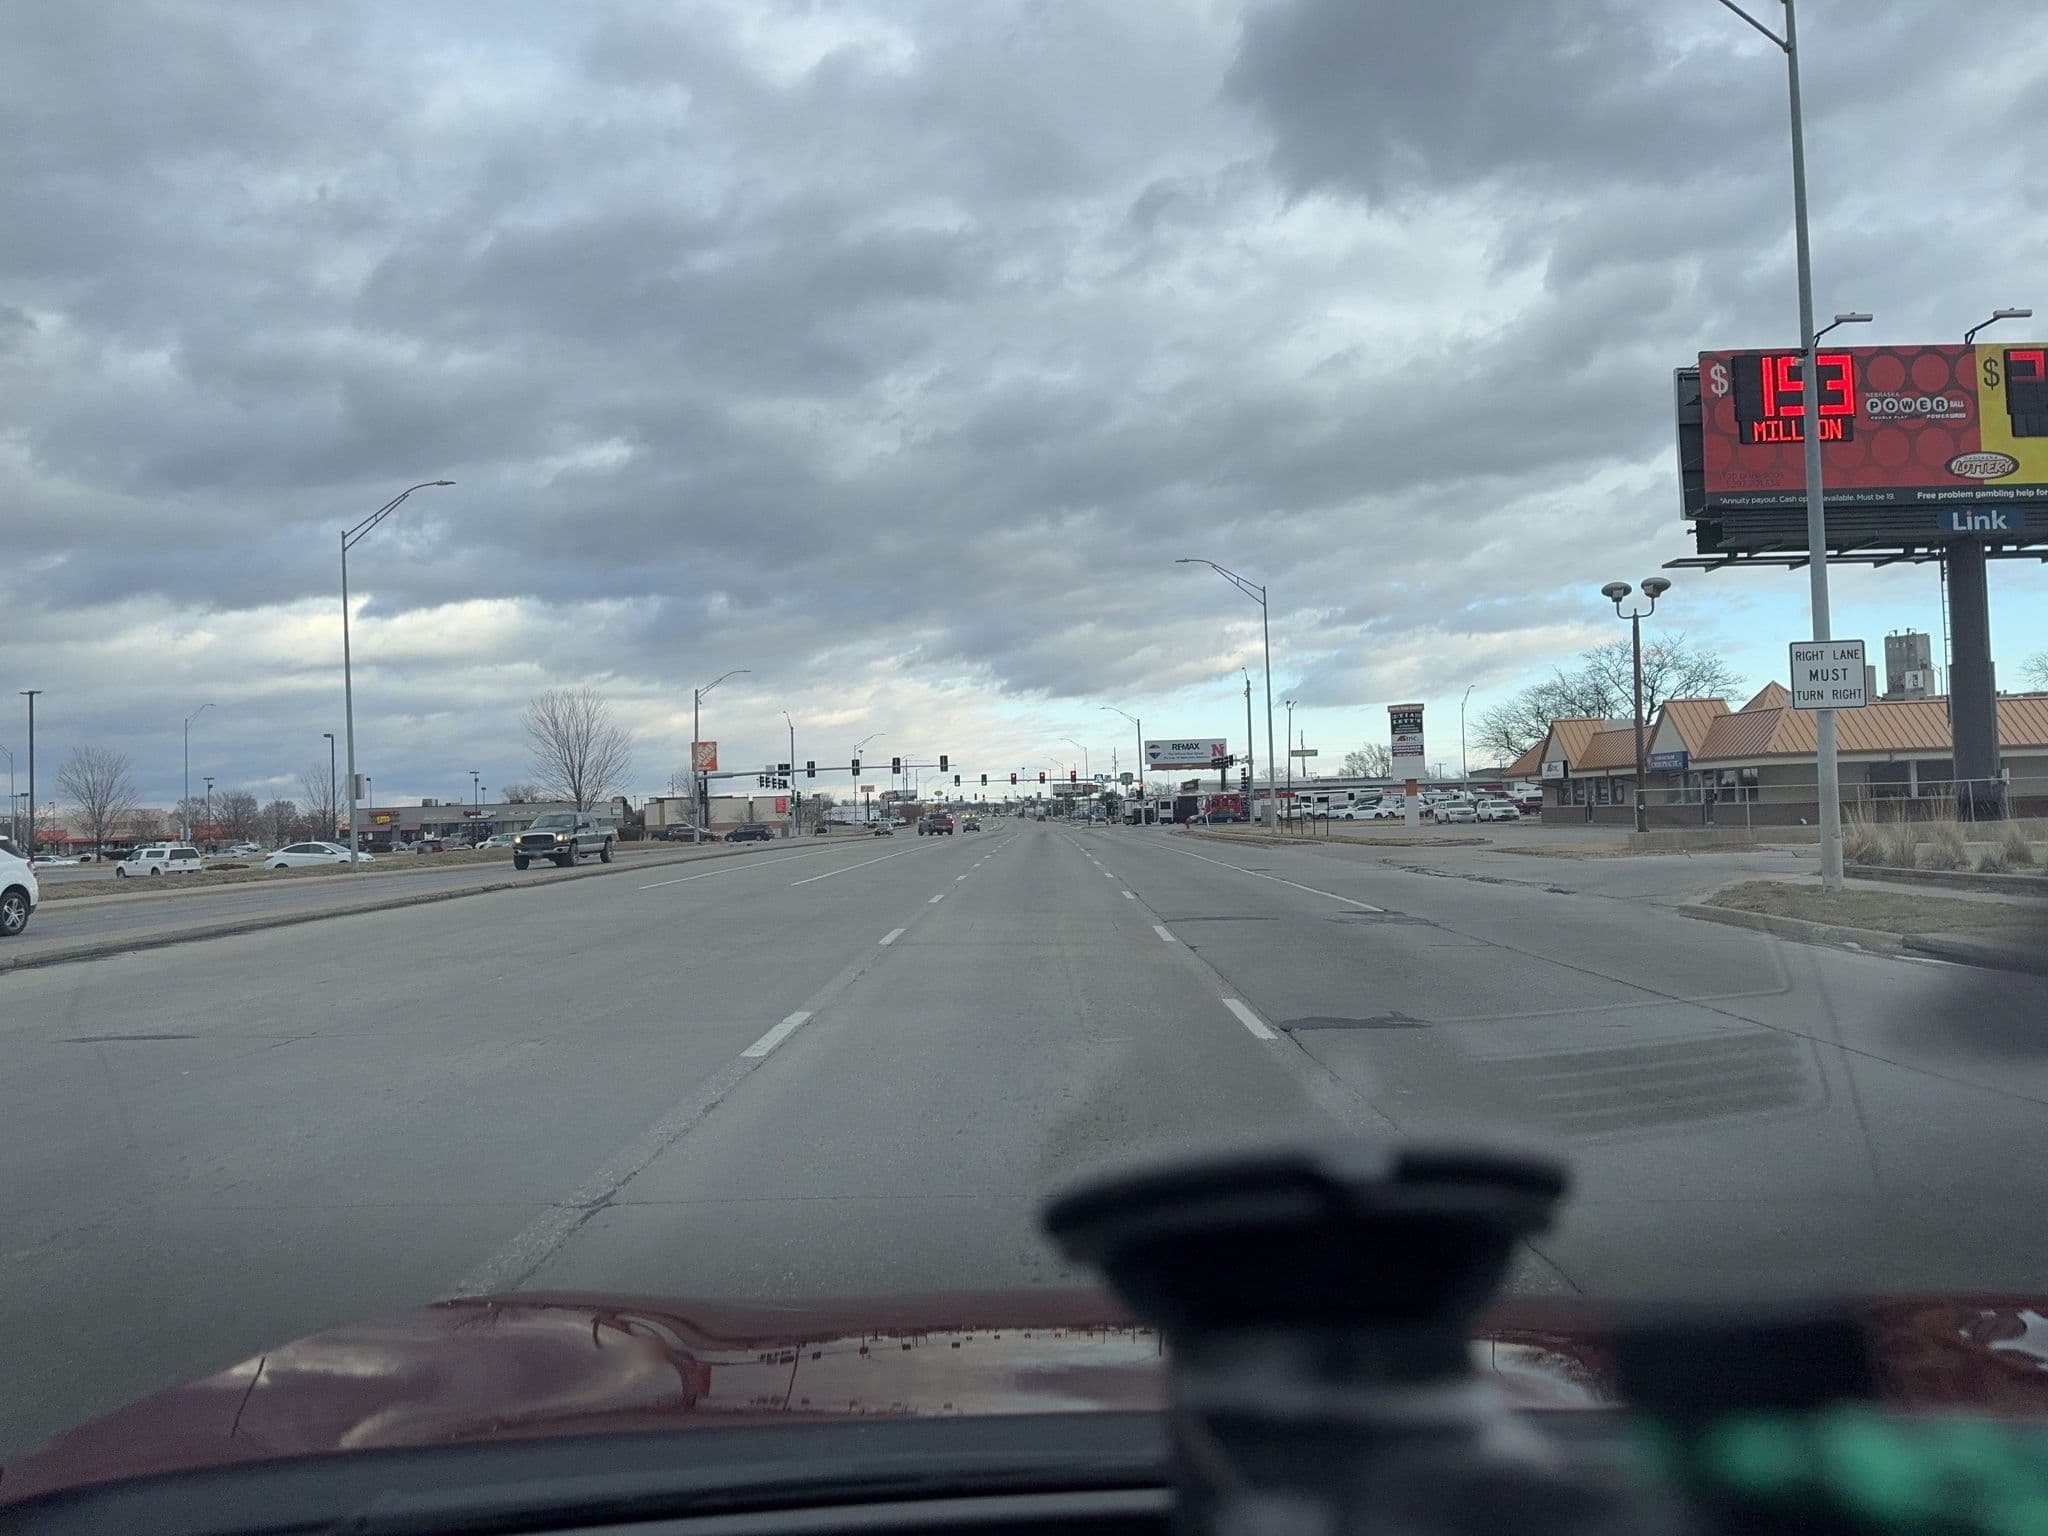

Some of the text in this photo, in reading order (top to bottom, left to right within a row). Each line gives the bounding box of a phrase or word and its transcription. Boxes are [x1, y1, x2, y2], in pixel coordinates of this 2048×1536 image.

[1710, 363, 1729, 397] $
[1983, 356, 2000, 391] $
[1754, 418, 1842, 442] MILLON
[1954, 459, 2013, 475] LOTTERY
[1780, 495, 1797, 503] Cash
[1917, 488, 2048, 500] Free problem gambling help for
[1952, 510, 2007, 531] Link
[1795, 649, 1861, 661] RIGHT LANE
[1809, 668, 1848, 682] MUST
[1796, 688, 1862, 701] TURN RIGHT
